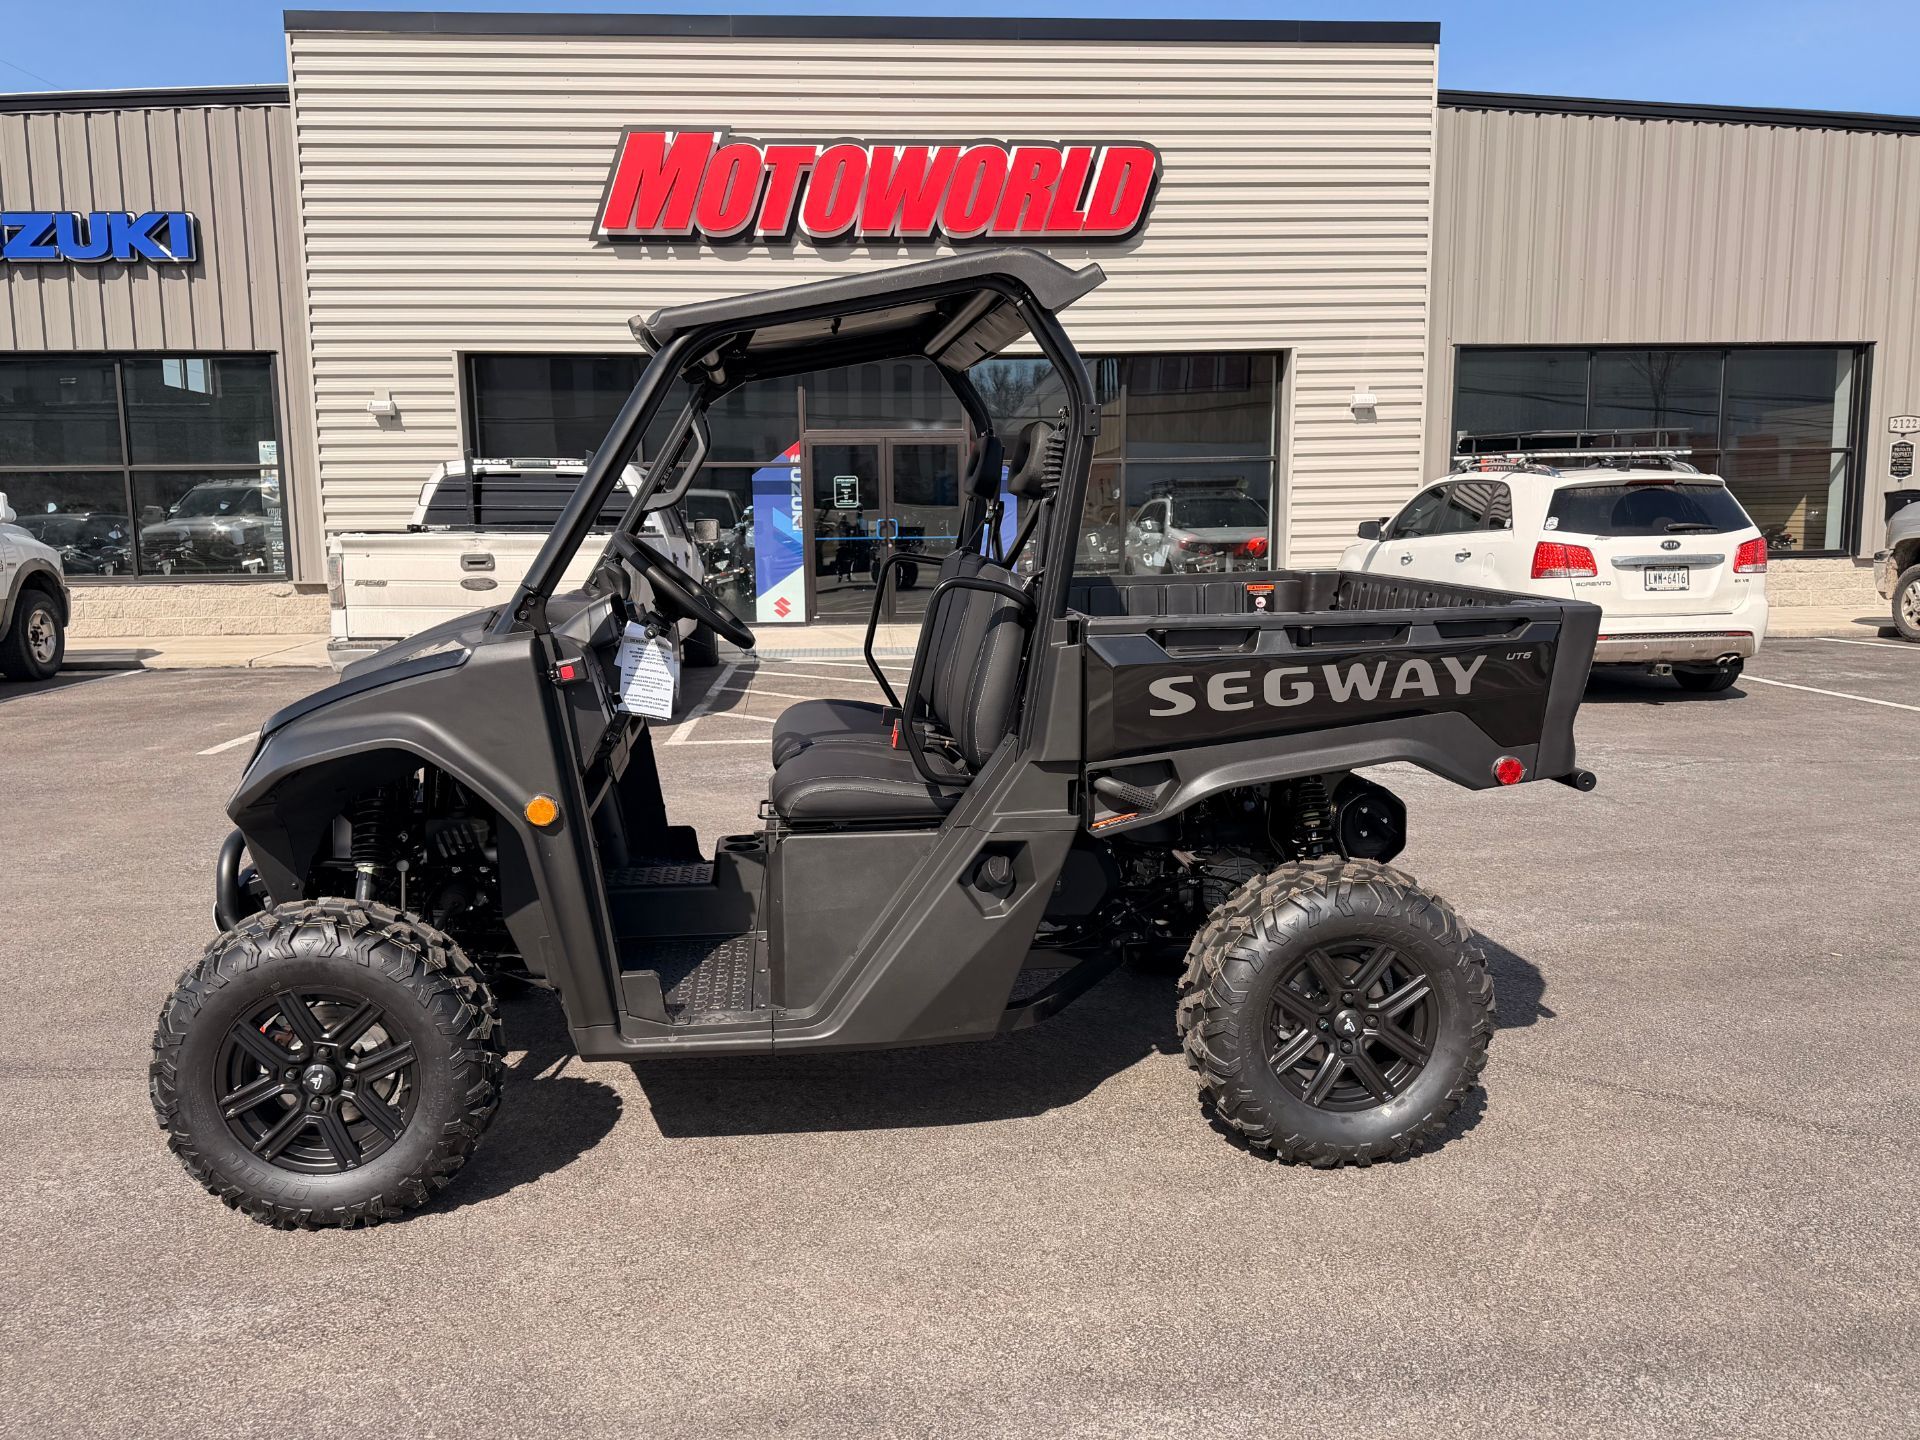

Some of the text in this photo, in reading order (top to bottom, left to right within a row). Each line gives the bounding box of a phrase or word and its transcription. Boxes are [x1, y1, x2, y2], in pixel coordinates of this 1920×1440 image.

[600, 131, 1160, 237] MOTOWORLD
[0, 212, 195, 261] ZUKI
[1892, 418, 1917, 428] 2122
[1663, 541, 1679, 549] KIA
[1506, 651, 1533, 660] UT6
[1147, 654, 1488, 717] SEGWAY
